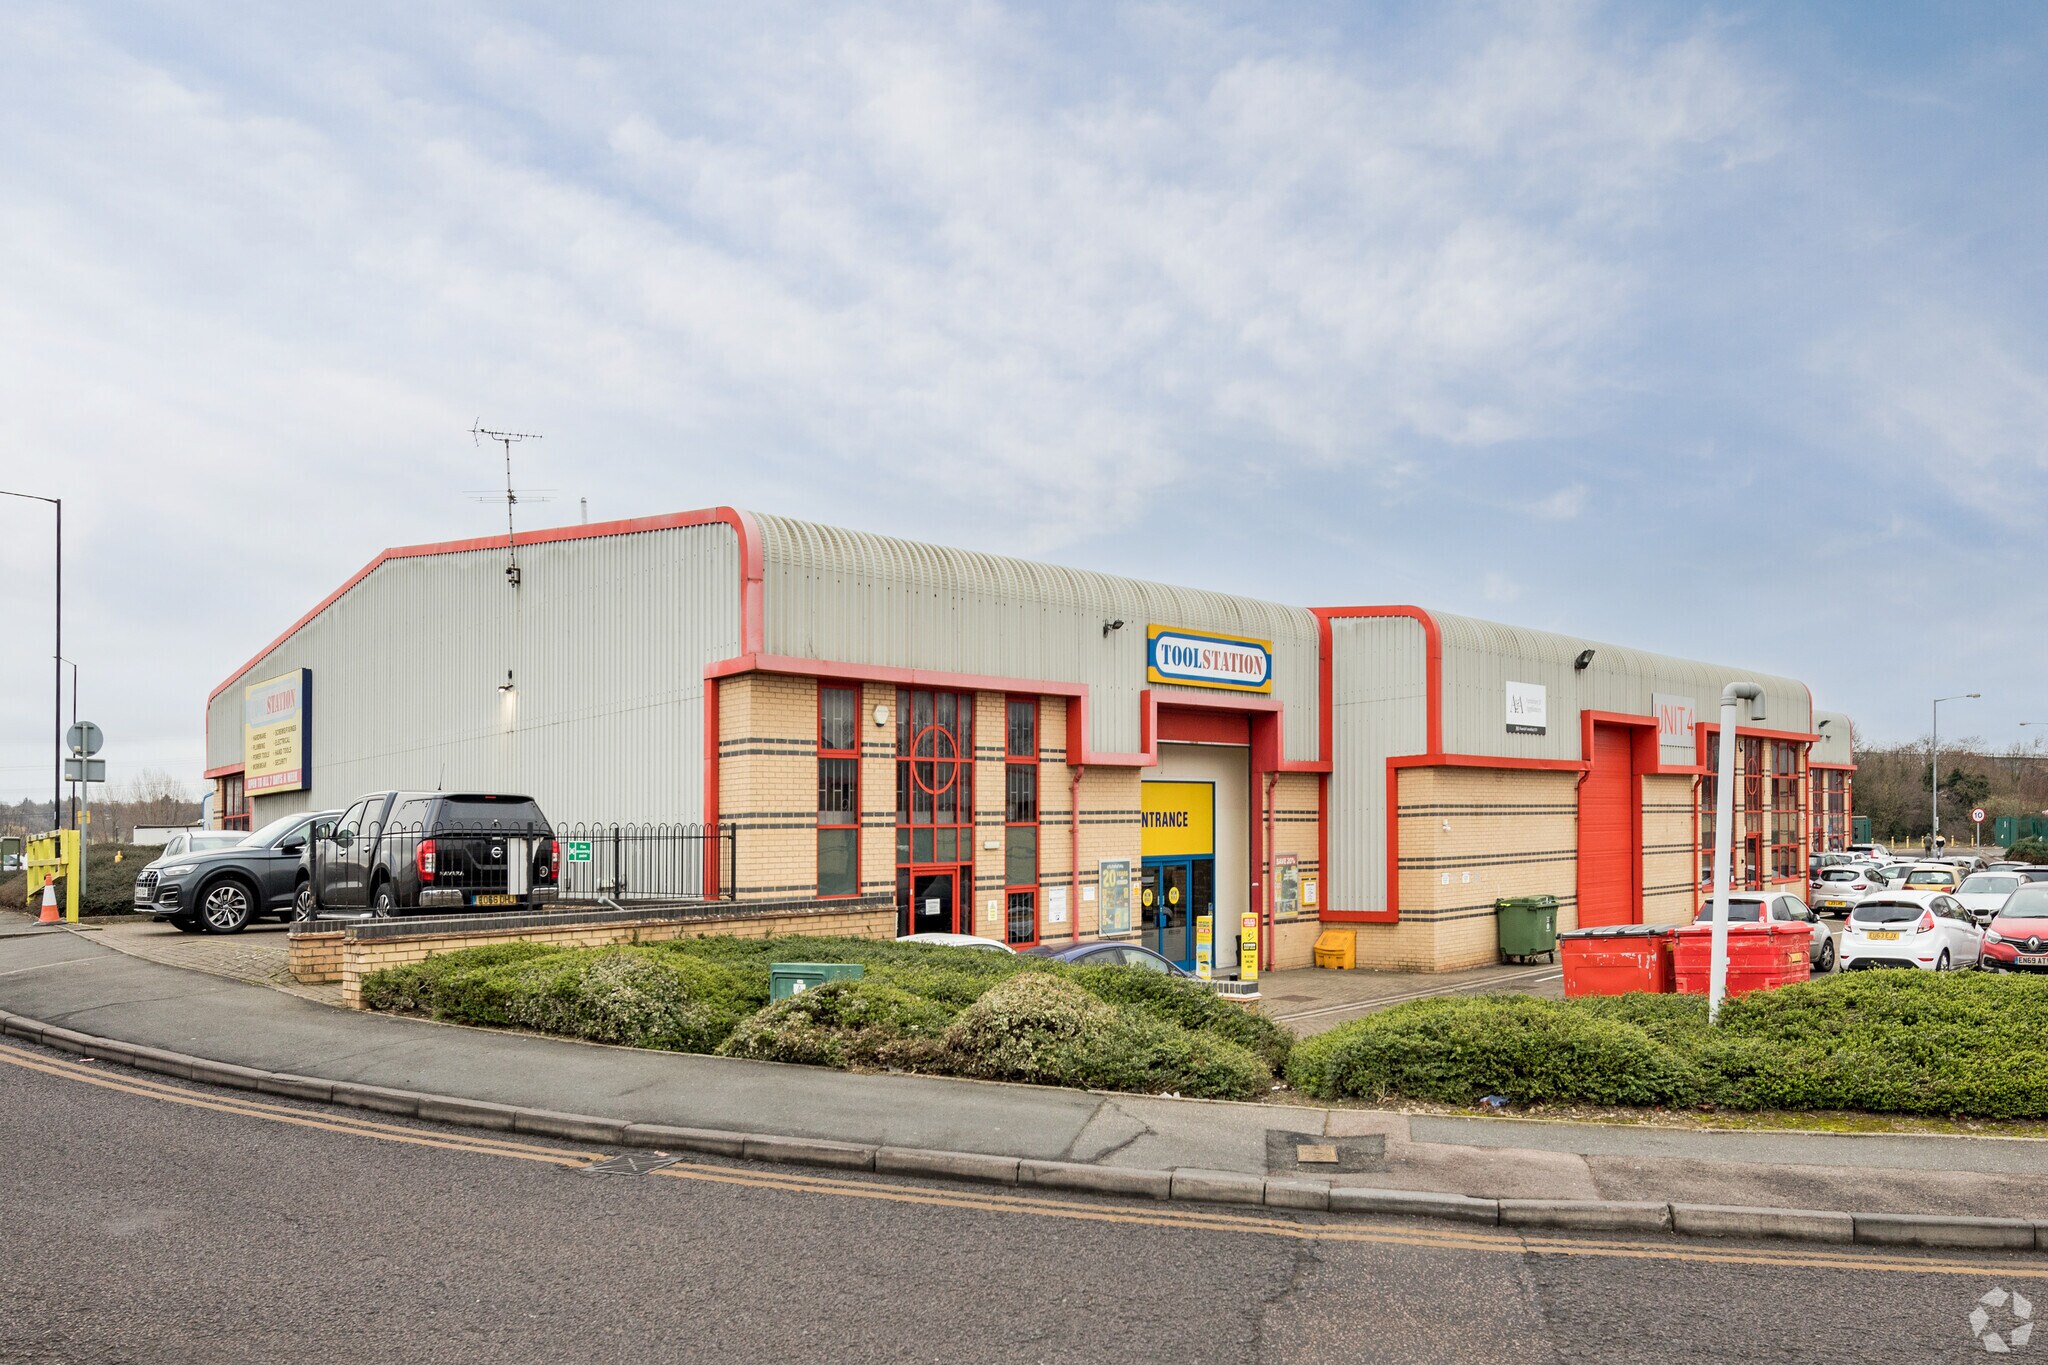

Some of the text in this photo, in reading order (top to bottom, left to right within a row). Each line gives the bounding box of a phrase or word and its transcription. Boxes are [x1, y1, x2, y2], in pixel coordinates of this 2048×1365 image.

[1161, 643, 1263, 675] TOOLSTATION
[1654, 703, 1694, 736] UNIT 4
[1141, 811, 1188, 828] NTRANCE
[1974, 811, 1983, 819] 10
